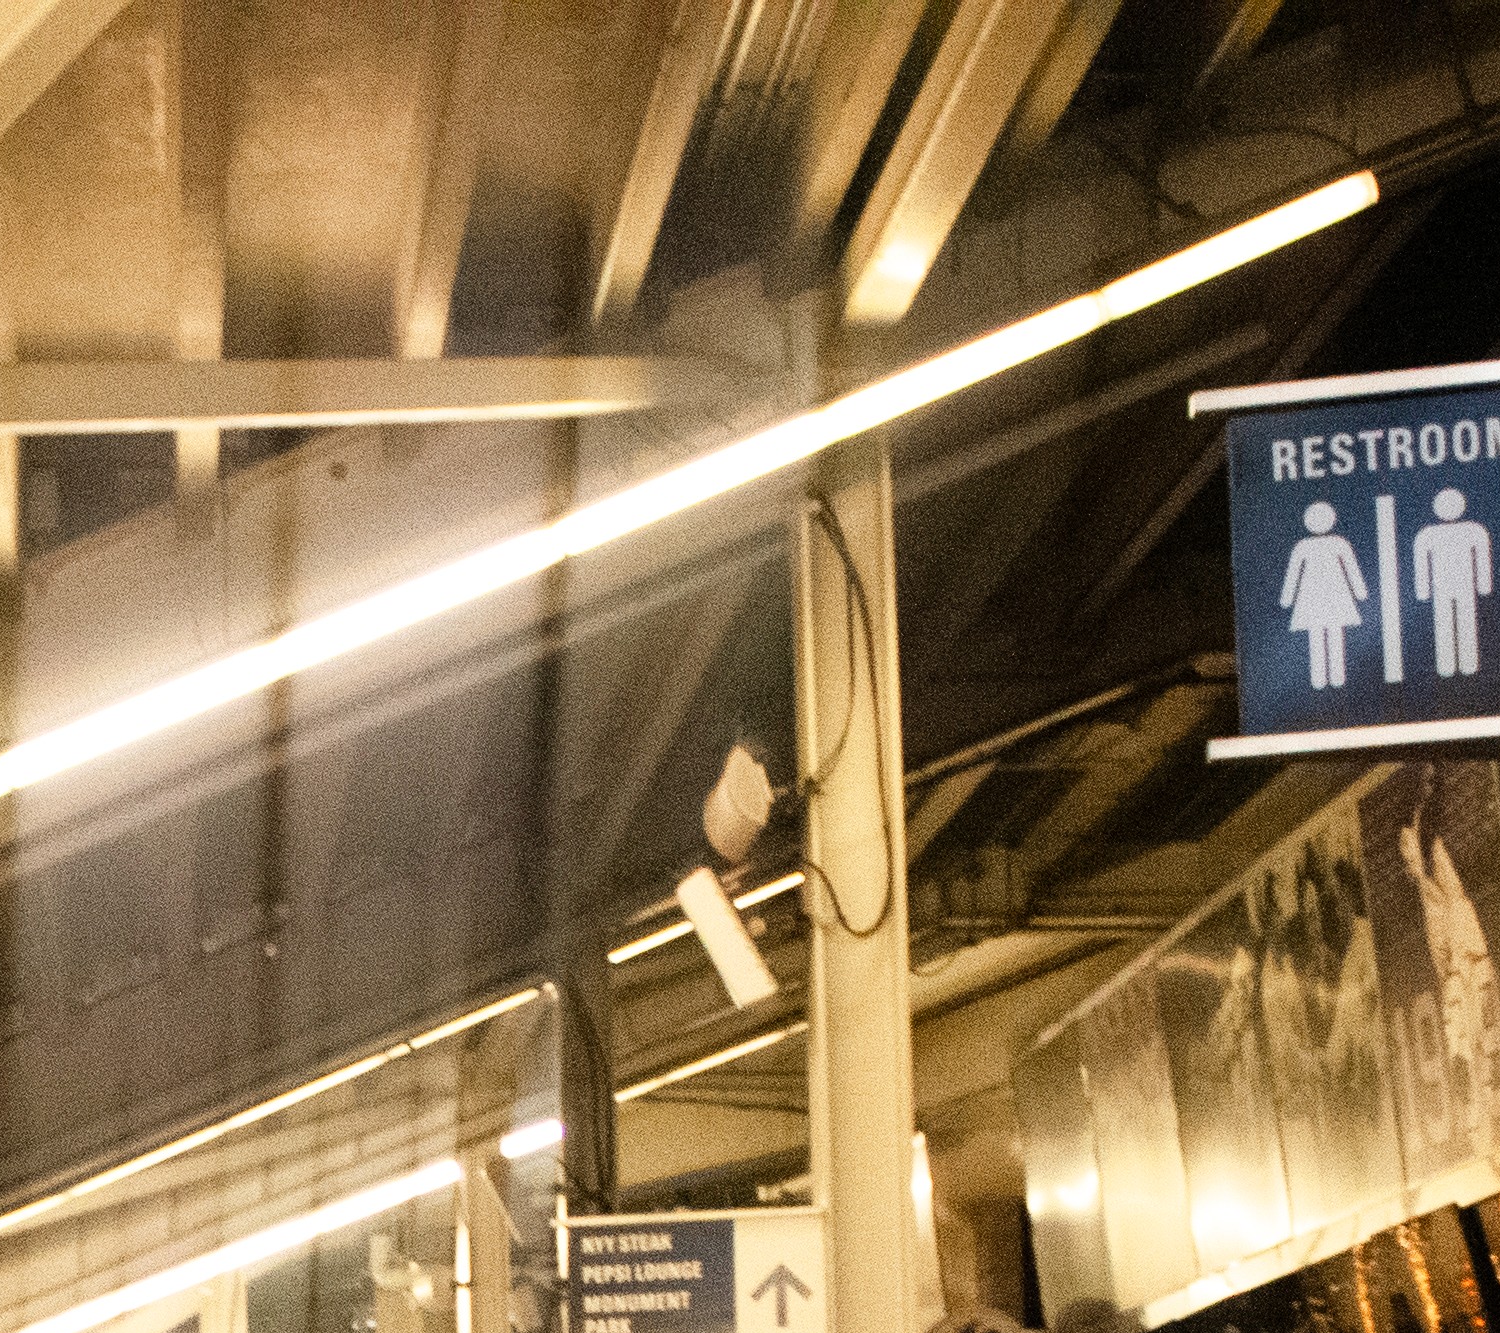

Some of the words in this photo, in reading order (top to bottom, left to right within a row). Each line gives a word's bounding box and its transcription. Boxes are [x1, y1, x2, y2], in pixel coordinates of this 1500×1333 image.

[618, 1232, 674, 1252] STEAK
[581, 1264, 632, 1284] PEPSI
[634, 1260, 703, 1282] LOUNGE
[583, 1291, 691, 1314] MONUMENT
